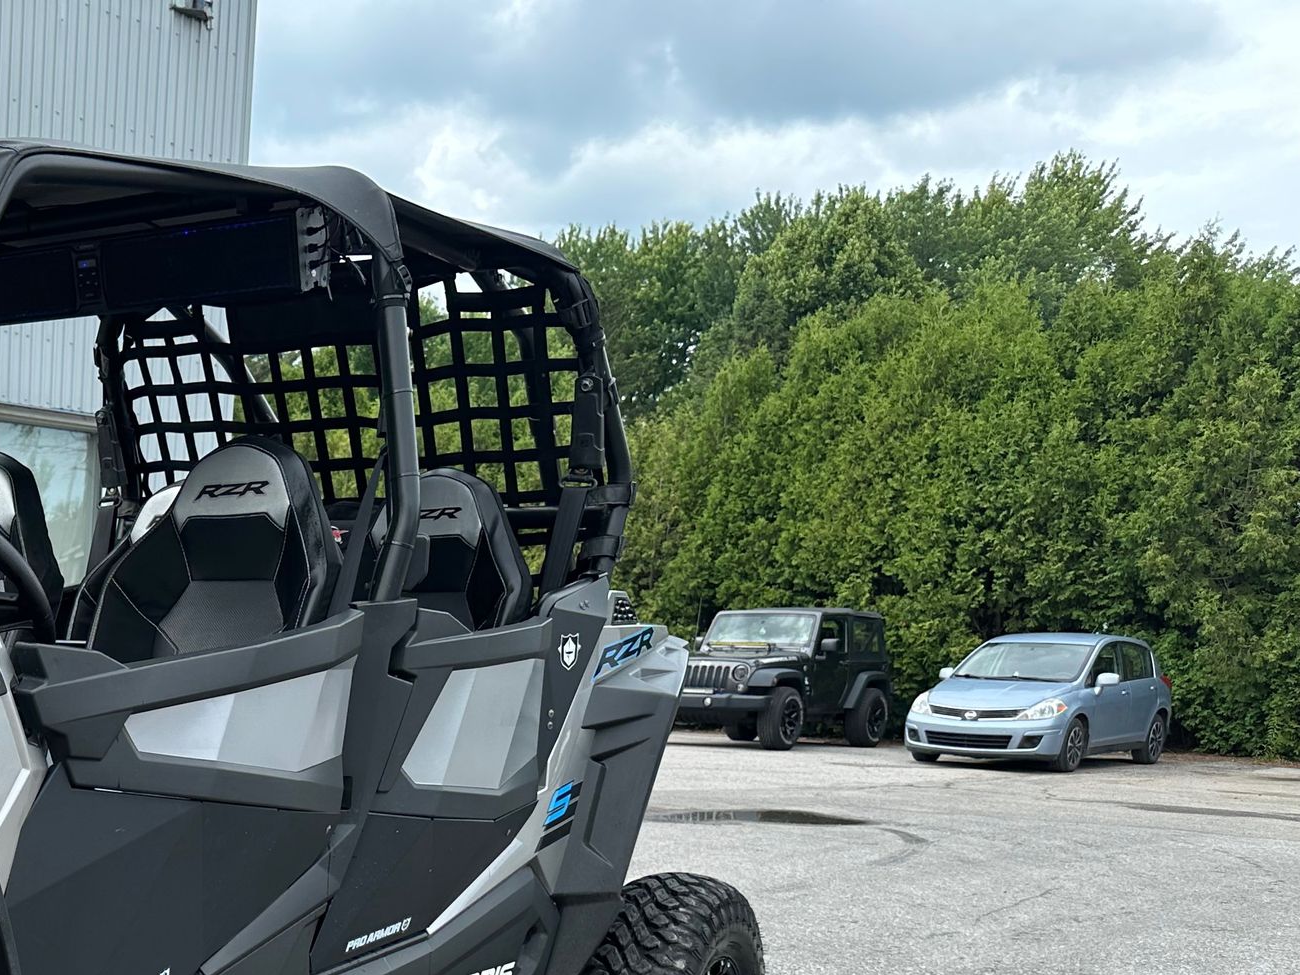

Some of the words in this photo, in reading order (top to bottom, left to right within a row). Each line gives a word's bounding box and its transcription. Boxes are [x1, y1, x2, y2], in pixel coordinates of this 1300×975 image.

[193, 480, 270, 502] RZR
[420, 506, 463, 521] ZR
[593, 627, 654, 681] RZR
[345, 935, 368, 953] PRO
[367, 921, 402, 945] ARMOR
